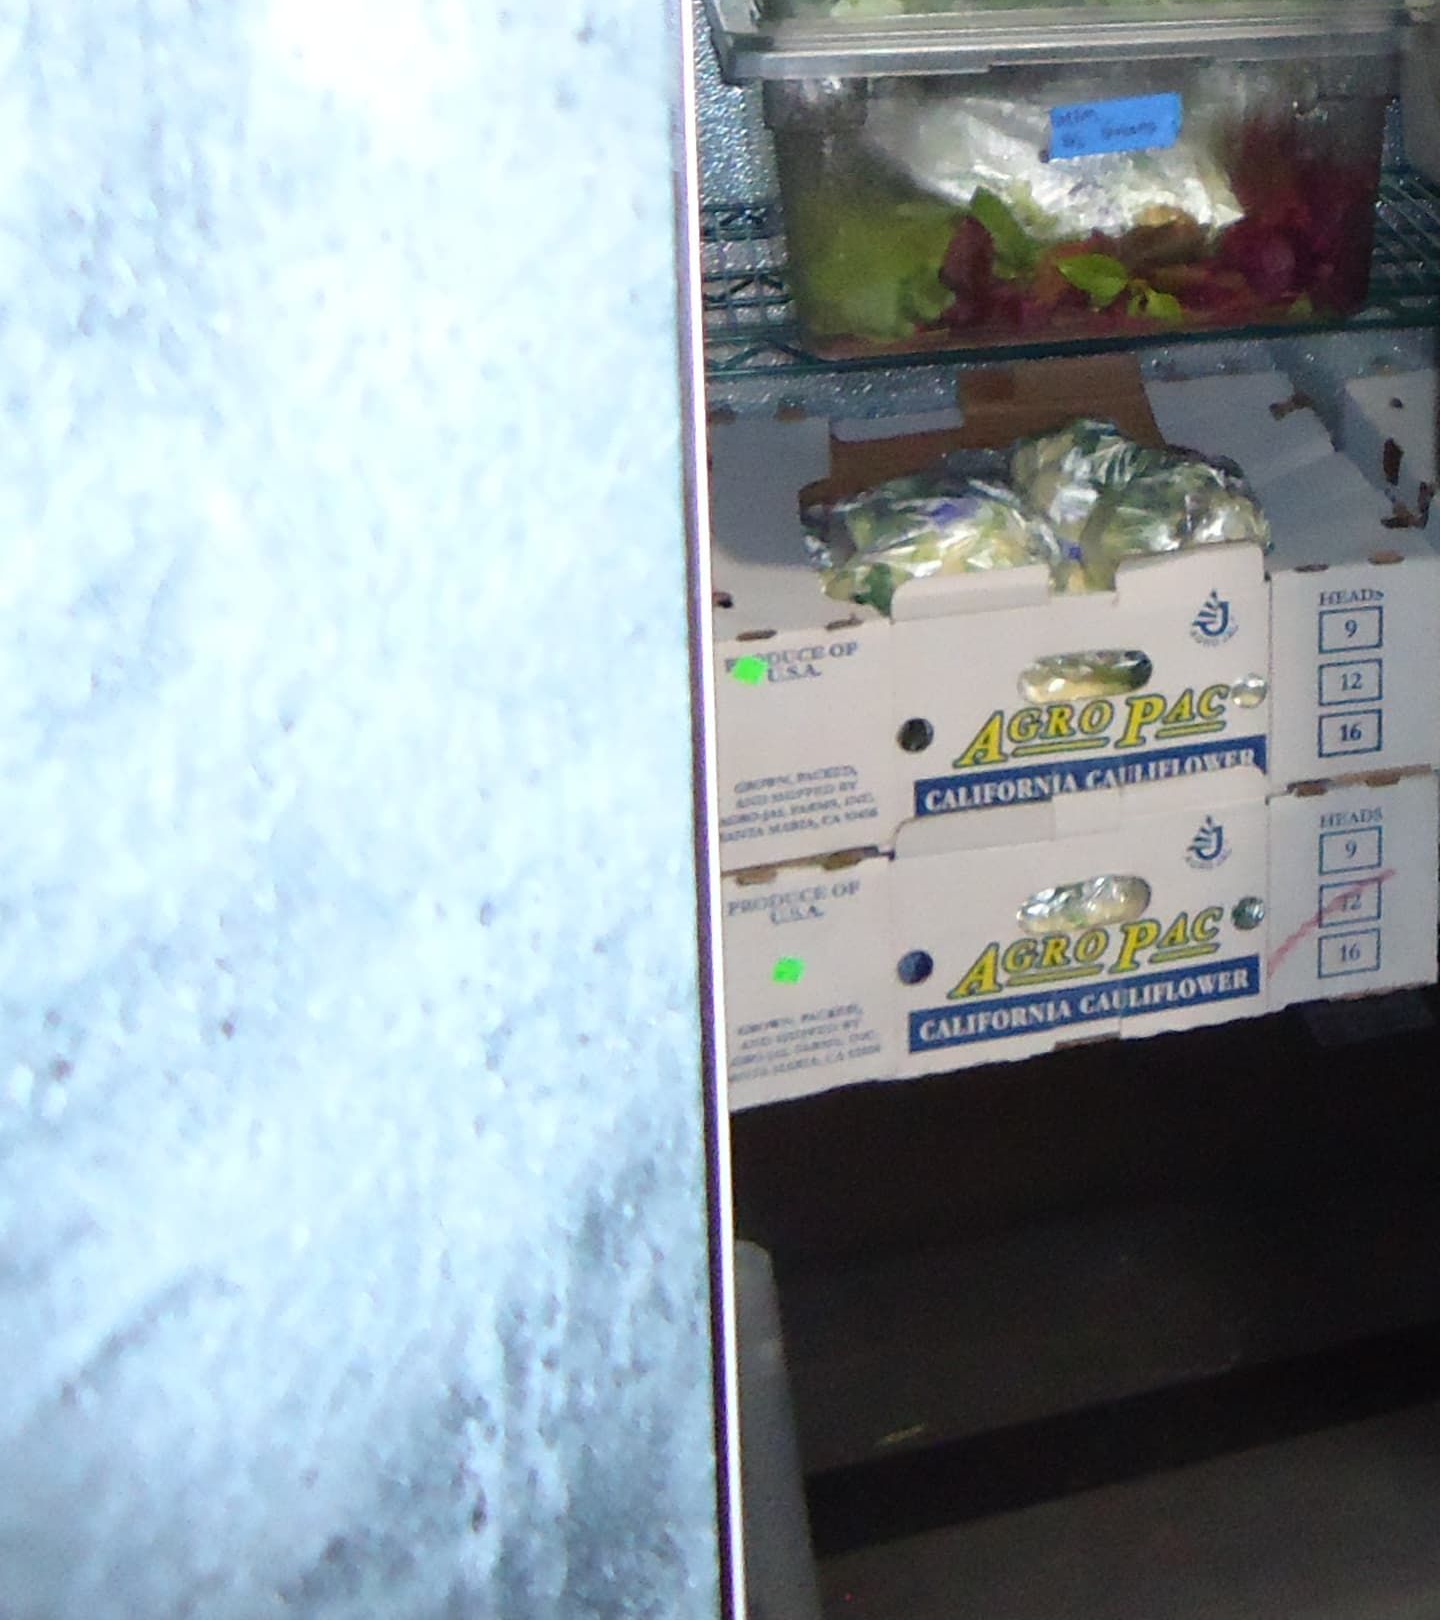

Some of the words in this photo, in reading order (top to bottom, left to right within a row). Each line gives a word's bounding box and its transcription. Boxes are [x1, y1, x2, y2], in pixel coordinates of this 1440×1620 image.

[1319, 588, 1385, 606] HEADS
[1344, 619, 1358, 638] 9
[829, 641, 858, 658] OF
[1340, 671, 1363, 692] 12
[952, 699, 1113, 768] AGRO
[1113, 683, 1232, 749] PAC
[1339, 721, 1362, 743] 16
[924, 768, 1081, 812] CALIFORNIA
[1082, 747, 1256, 790] CAULIFLOWER
[1319, 806, 1384, 828] HEADS
[1344, 839, 1358, 859] 9
[727, 885, 827, 917] PRODUCE
[831, 880, 861, 898] OF
[1340, 892, 1362, 913] 12
[947, 928, 1110, 1000] AGRO
[1108, 906, 1225, 974] PAC
[1339, 941, 1361, 963] 16
[918, 997, 1073, 1042] CALIFORNIA
[1079, 967, 1250, 1016] CAULIFLOWER
